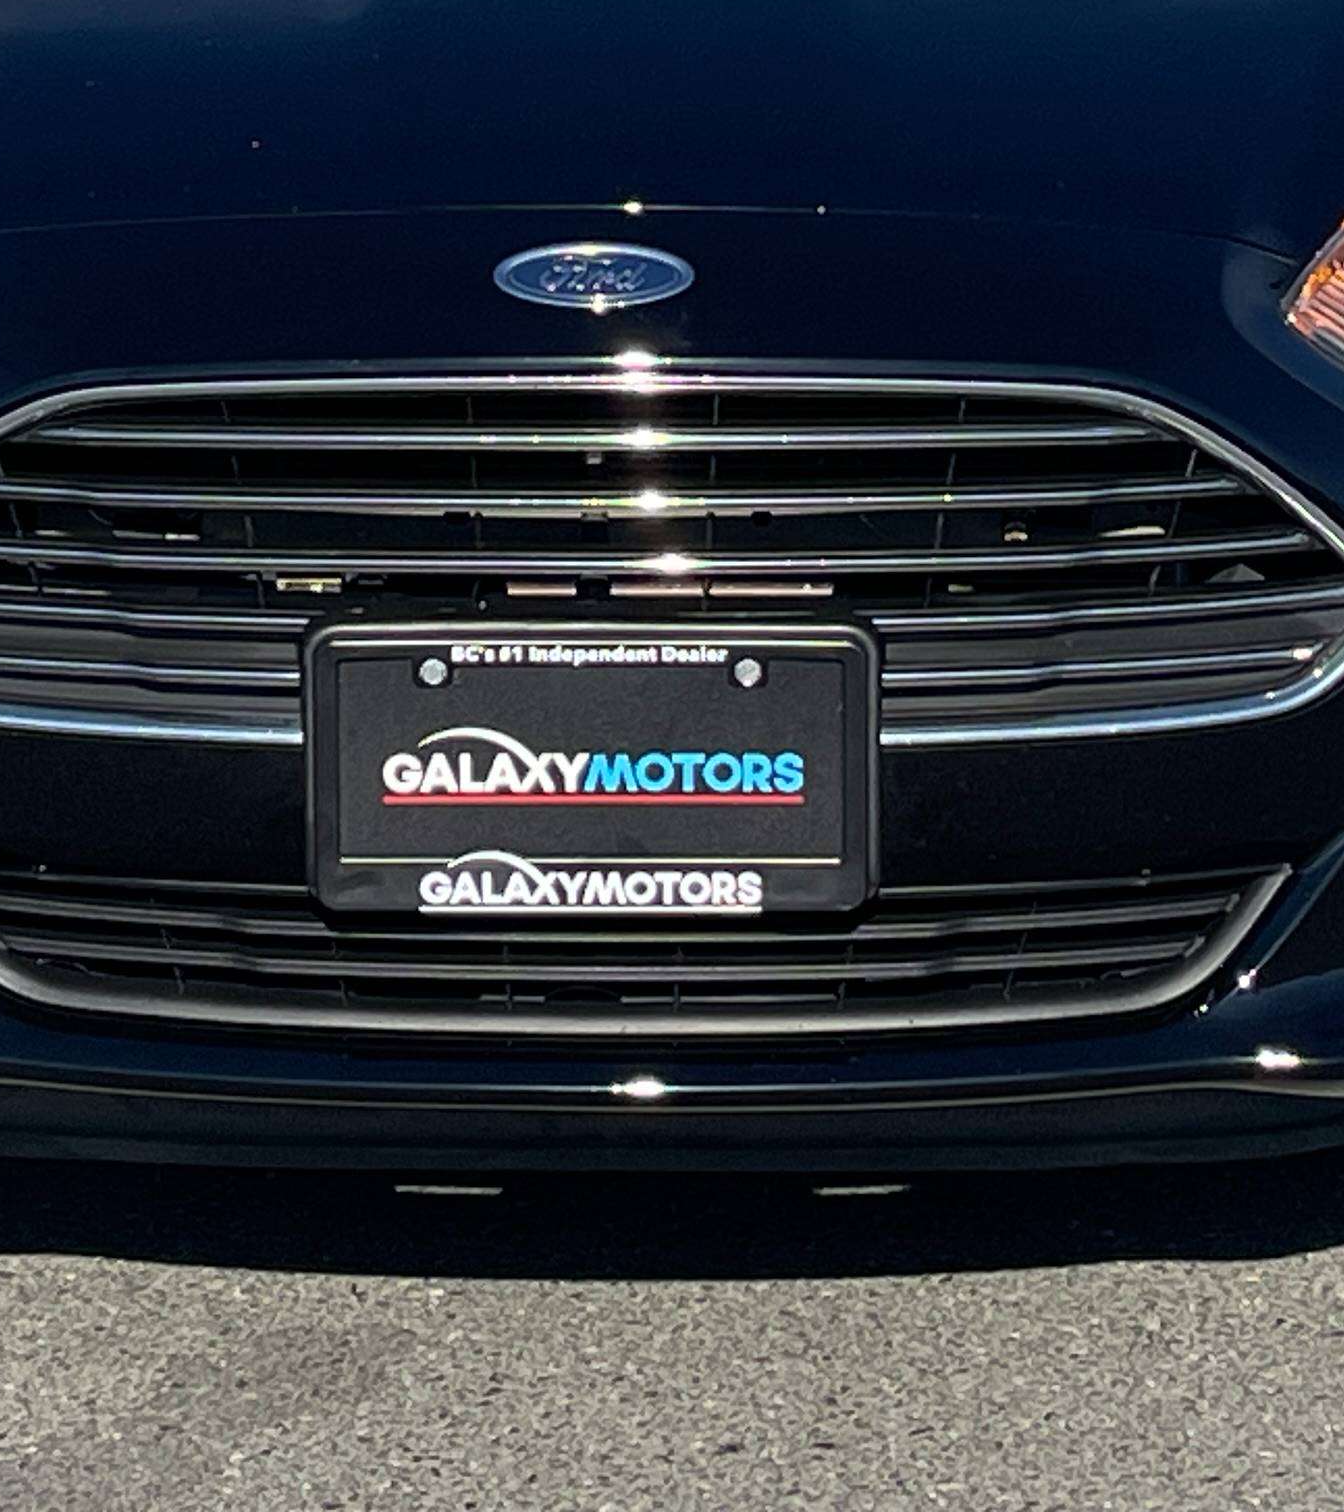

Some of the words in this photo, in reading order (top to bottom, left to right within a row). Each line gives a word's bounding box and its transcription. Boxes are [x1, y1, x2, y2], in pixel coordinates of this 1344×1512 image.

[528, 644, 657, 666] Independent
[661, 644, 729, 663] Dealer
[382, 751, 805, 794] GALAXYMOTORS
[419, 870, 762, 905] GALAXYMOTORS
